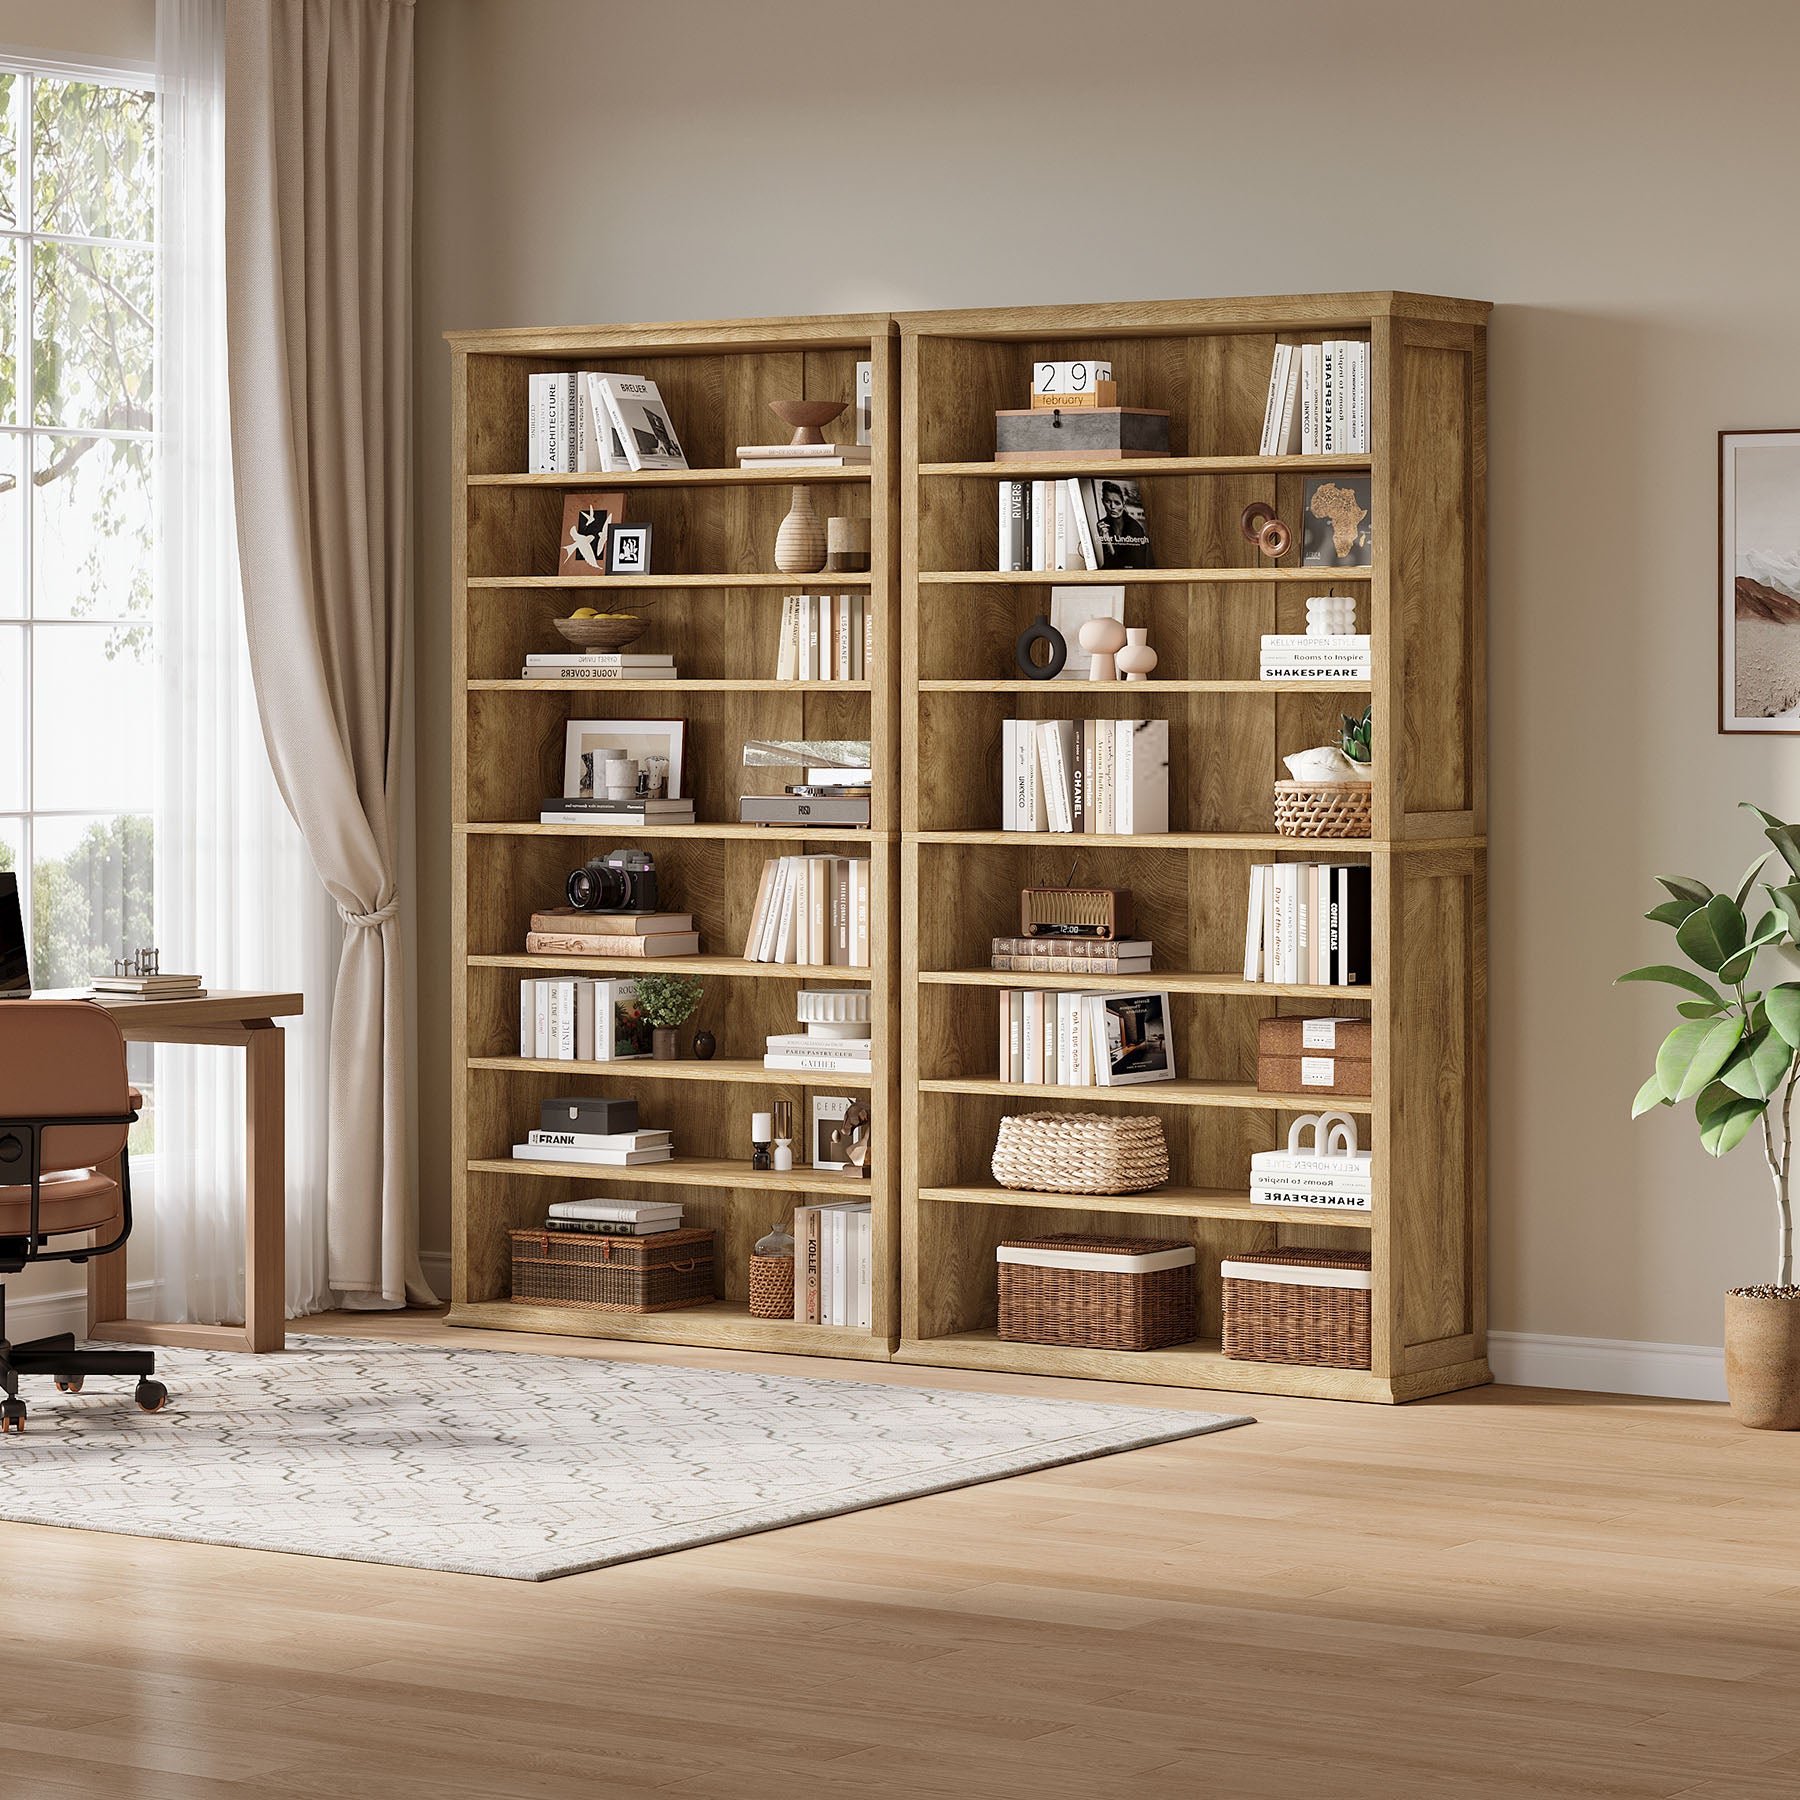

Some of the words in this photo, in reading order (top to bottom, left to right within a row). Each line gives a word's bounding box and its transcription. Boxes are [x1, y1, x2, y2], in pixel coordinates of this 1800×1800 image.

[620, 383, 648, 394] BREUER
[1042, 395, 1084, 406] february
[1012, 484, 1021, 518] RIVERS
[1114, 535, 1150, 545] Lindbergh
[1335, 654, 1364, 662] Inspire
[1266, 669, 1358, 677] SHAKESPEARE
[1074, 770, 1082, 819] CHANEL
[1086, 777, 1094, 807] lovelace
[858, 886, 866, 902] GOOD
[1275, 907, 1282, 916] of
[1330, 902, 1338, 928] COFFEE
[1060, 926, 1079, 934] 12:00
[1330, 929, 1338, 951] ATLAS
[1274, 936, 1282, 967] design
[562, 1020, 570, 1051] VENICE
[801, 1058, 837, 1069] GATHER
[539, 1135, 575, 1145] FRANK
